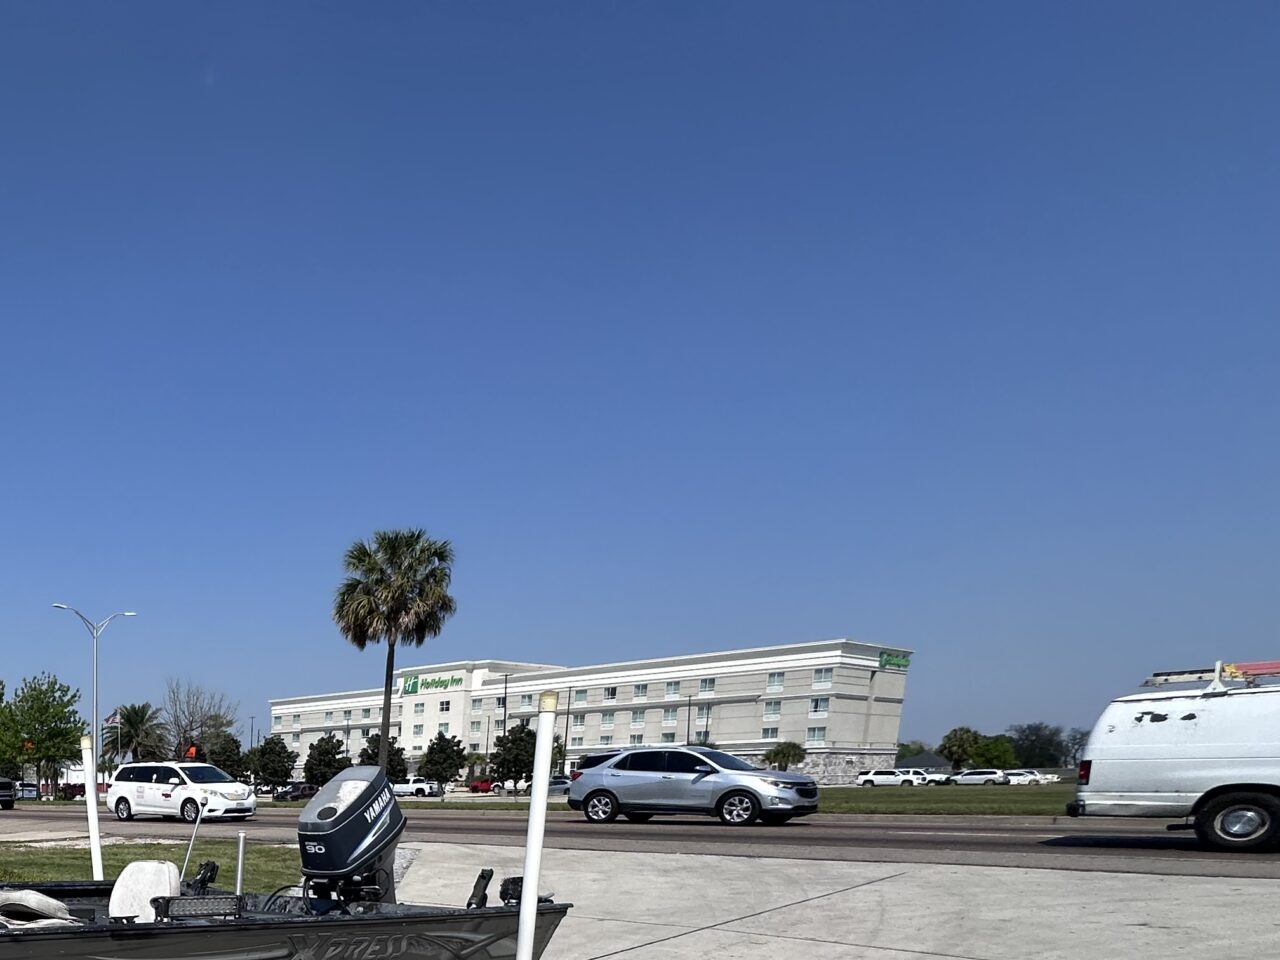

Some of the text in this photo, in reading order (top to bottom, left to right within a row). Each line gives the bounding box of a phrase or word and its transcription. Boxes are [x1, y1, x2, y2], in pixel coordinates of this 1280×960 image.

[420, 675, 463, 690] Holiday Inn
[363, 787, 391, 823] YAMAHA
[305, 845, 326, 853] 90
